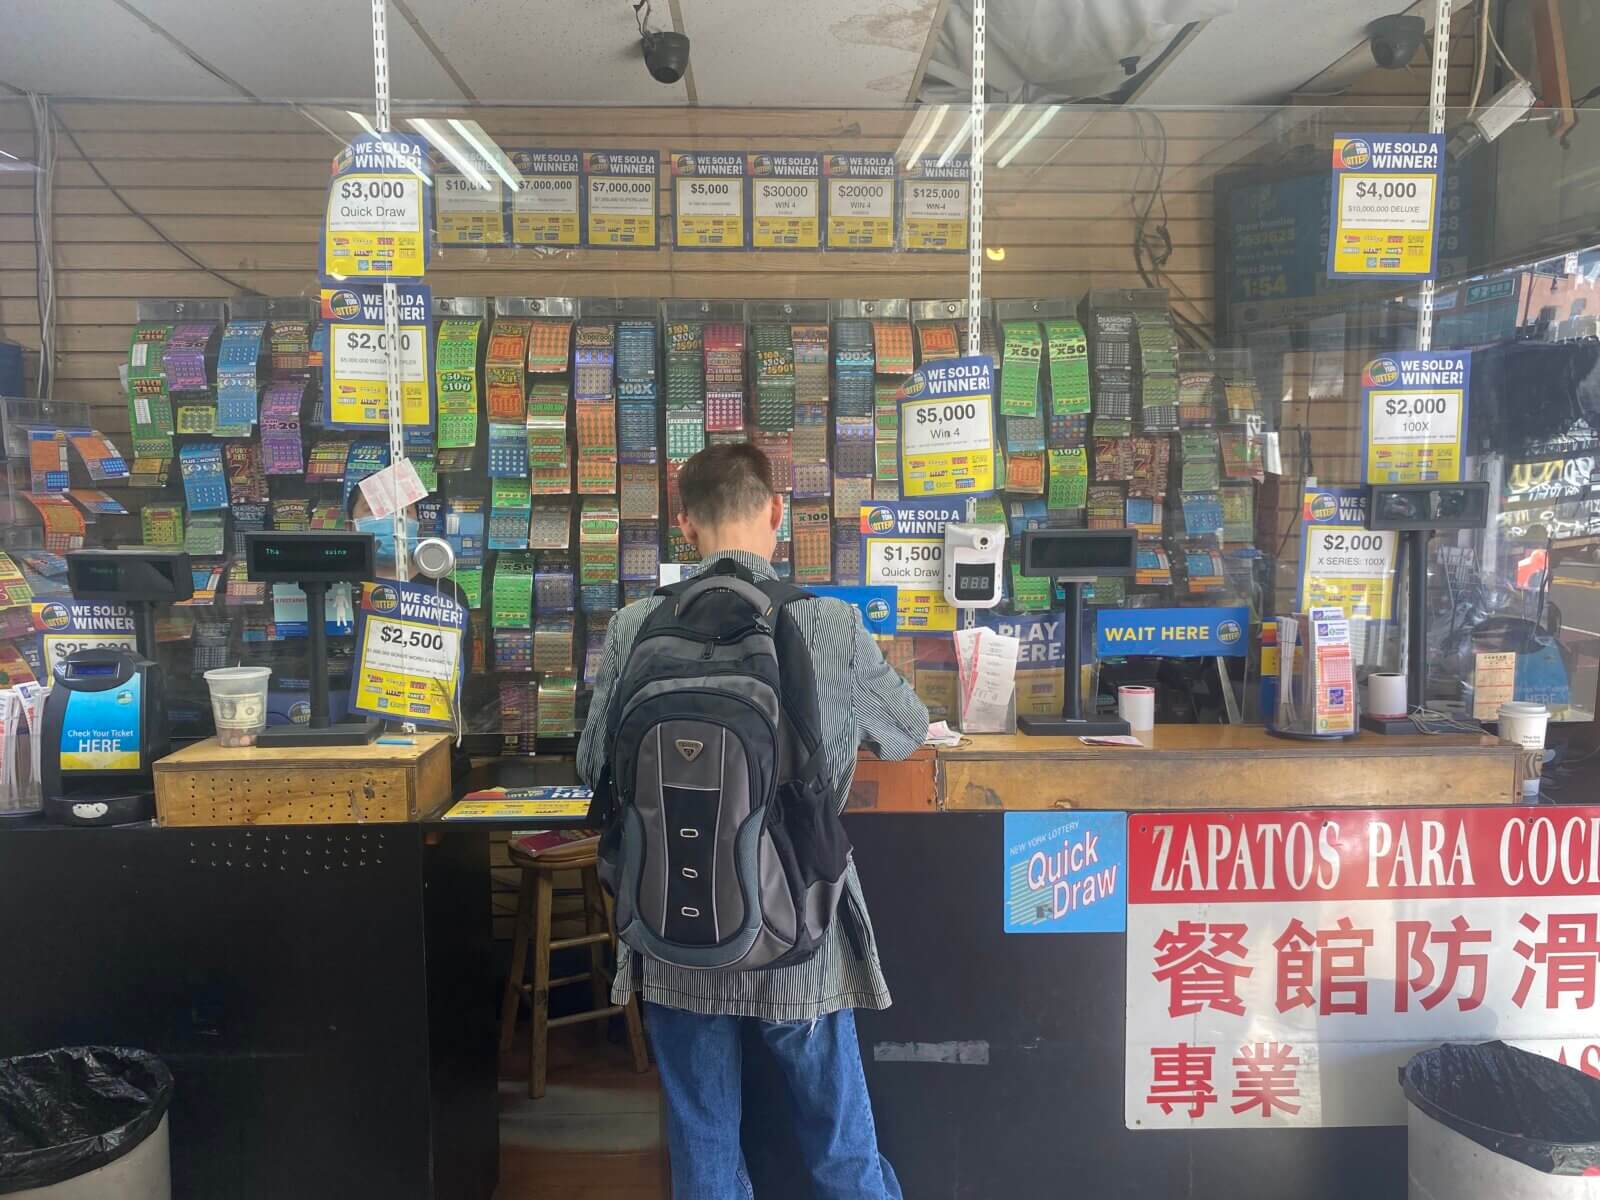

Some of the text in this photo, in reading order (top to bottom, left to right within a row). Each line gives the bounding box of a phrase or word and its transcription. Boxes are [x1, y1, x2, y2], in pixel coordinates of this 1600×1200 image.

[356, 144, 372, 153] WE
[409, 145, 421, 155] A
[1373, 143, 1438, 154] WE SOLD A
[355, 155, 421, 169] WINNER!
[533, 154, 578, 163] WE SOLD A
[610, 156, 655, 165] WE SOLD A
[697, 157, 742, 165] WE SOLD A
[774, 158, 819, 166] WE SOLD A
[850, 157, 894, 166] WE SOLD A
[1372, 155, 1437, 169] WINNER!
[533, 163, 578, 173] WINNER!
[610, 164, 655, 174] WINNER!
[698, 165, 742, 176] WINNER!
[774, 166, 819, 176] WINNER!
[850, 166, 894, 177] WINNER!
[925, 168, 969, 178] WINNER!
[341, 181, 404, 201] $3,000
[518, 181, 572, 191] $7,000,000
[592, 182, 651, 194] $7,000,000
[691, 183, 729, 196] $5,000
[763, 185, 808, 198] $30000
[838, 185, 884, 198] $20000
[1356, 182, 1416, 200] $4,000
[913, 188, 960, 200] $125,000
[341, 207, 405, 217] Quick Draw
[362, 294, 382, 306] WE
[416, 295, 425, 306] A
[364, 307, 425, 321] WINER!
[347, 332, 410, 352] $2,00
[1011, 348, 1040, 357] X50
[1057, 345, 1086, 355] X50
[1401, 360, 1464, 372] WE SOLD A
[928, 365, 990, 381] WE SOLD A
[1401, 372, 1463, 385] WINNER!
[620, 383, 653, 395] 100X
[928, 377, 990, 394] WINNER!
[1386, 398, 1446, 417] $2,000
[917, 404, 975, 424] $5,000
[1403, 422, 1429, 432] 100X
[930, 427, 960, 440] Win 4
[1340, 497, 1359, 507] WE
[897, 510, 960, 520] WE SOLD A
[897, 522, 945, 534] WINNE
[1323, 534, 1382, 553] $2,000
[884, 546, 942, 565] $1,500
[882, 567, 940, 578] Quick Draw
[401, 590, 421, 601] WE
[423, 593, 453, 609] SOLD
[71, 606, 127, 616] WE SOLD
[401, 602, 463, 624] WINNER!
[72, 618, 135, 630] WINNER
[381, 626, 443, 651] $2,500
[1105, 626, 1209, 641] WAIT HERE
[1017, 642, 1065, 662] ERE.
[68, 730, 134, 738] Check Your Ticket
[79, 739, 121, 753] HERE
[1010, 821, 1080, 857] NEW YORK LOTTERY
[1028, 831, 1098, 891] Quick
[1151, 821, 1341, 892] ZAPATOS
[1366, 819, 1476, 888] PARA
[1053, 864, 1118, 920] Draw
[1146, 1043, 1302, 1118] 專業
